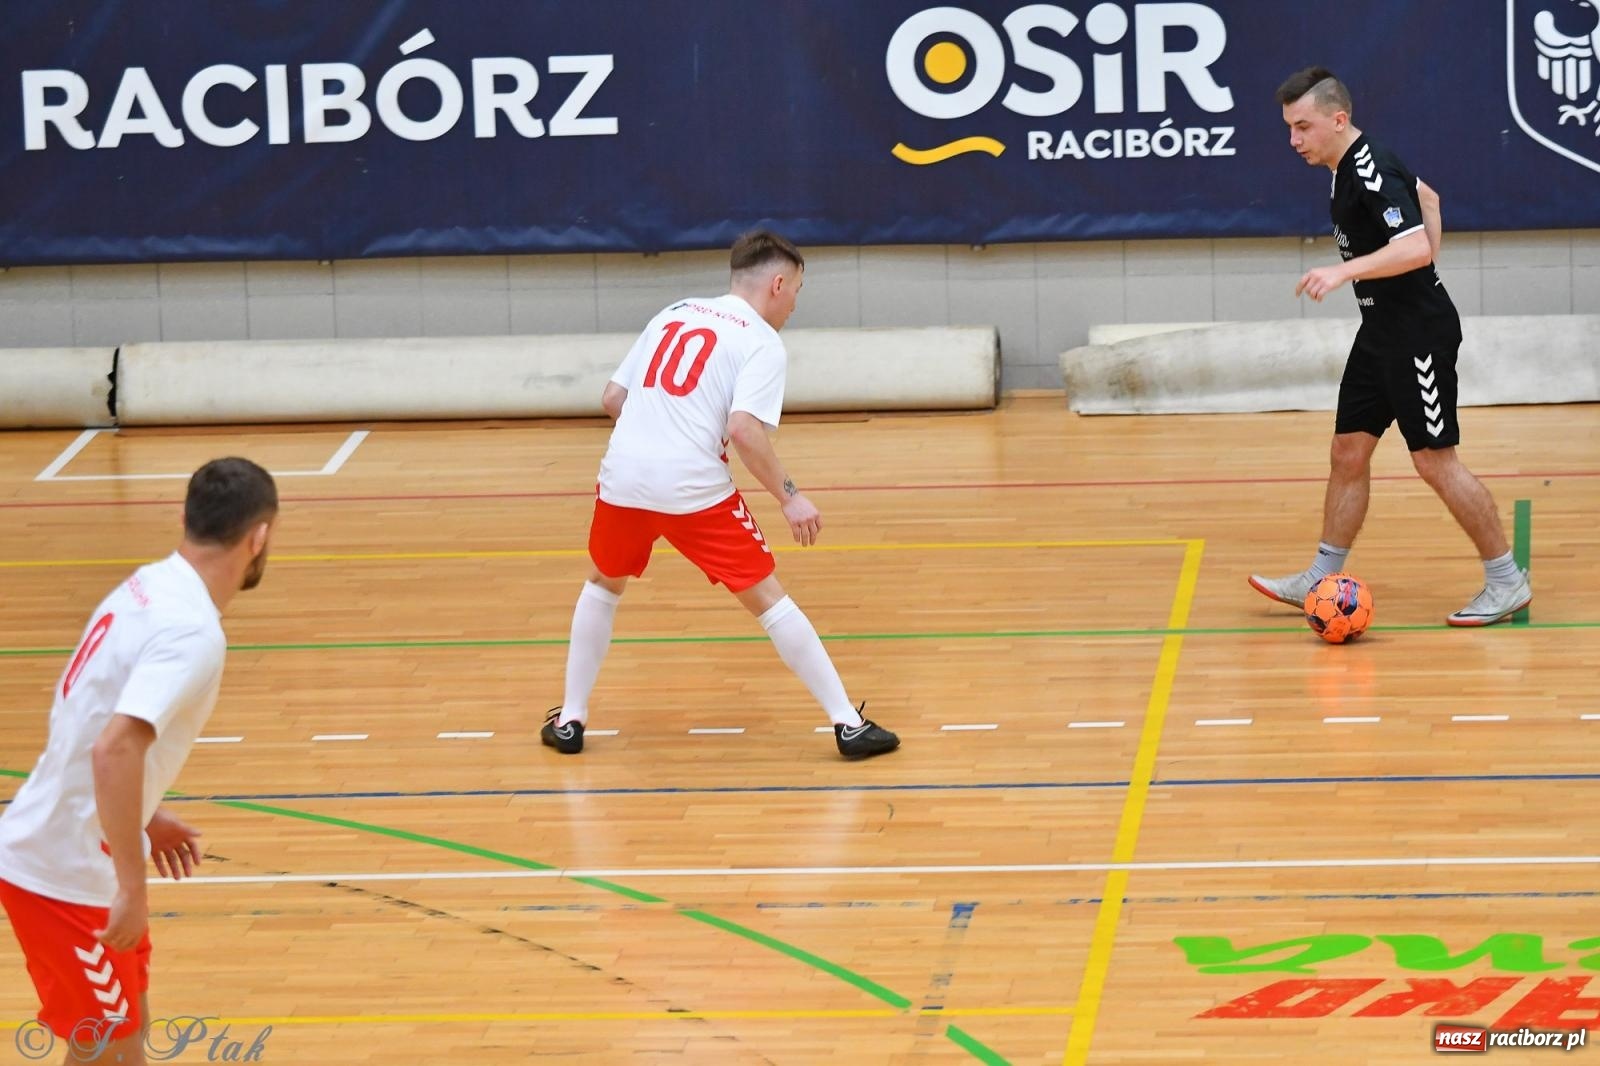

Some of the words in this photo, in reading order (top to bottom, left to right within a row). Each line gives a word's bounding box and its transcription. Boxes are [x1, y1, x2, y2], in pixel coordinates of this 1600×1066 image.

[22, 28, 618, 150] RACIBÓRZ
[886, 2, 1235, 119] OSiR
[1027, 117, 1236, 160] RACIBÓRZ
[643, 321, 718, 397] 10
